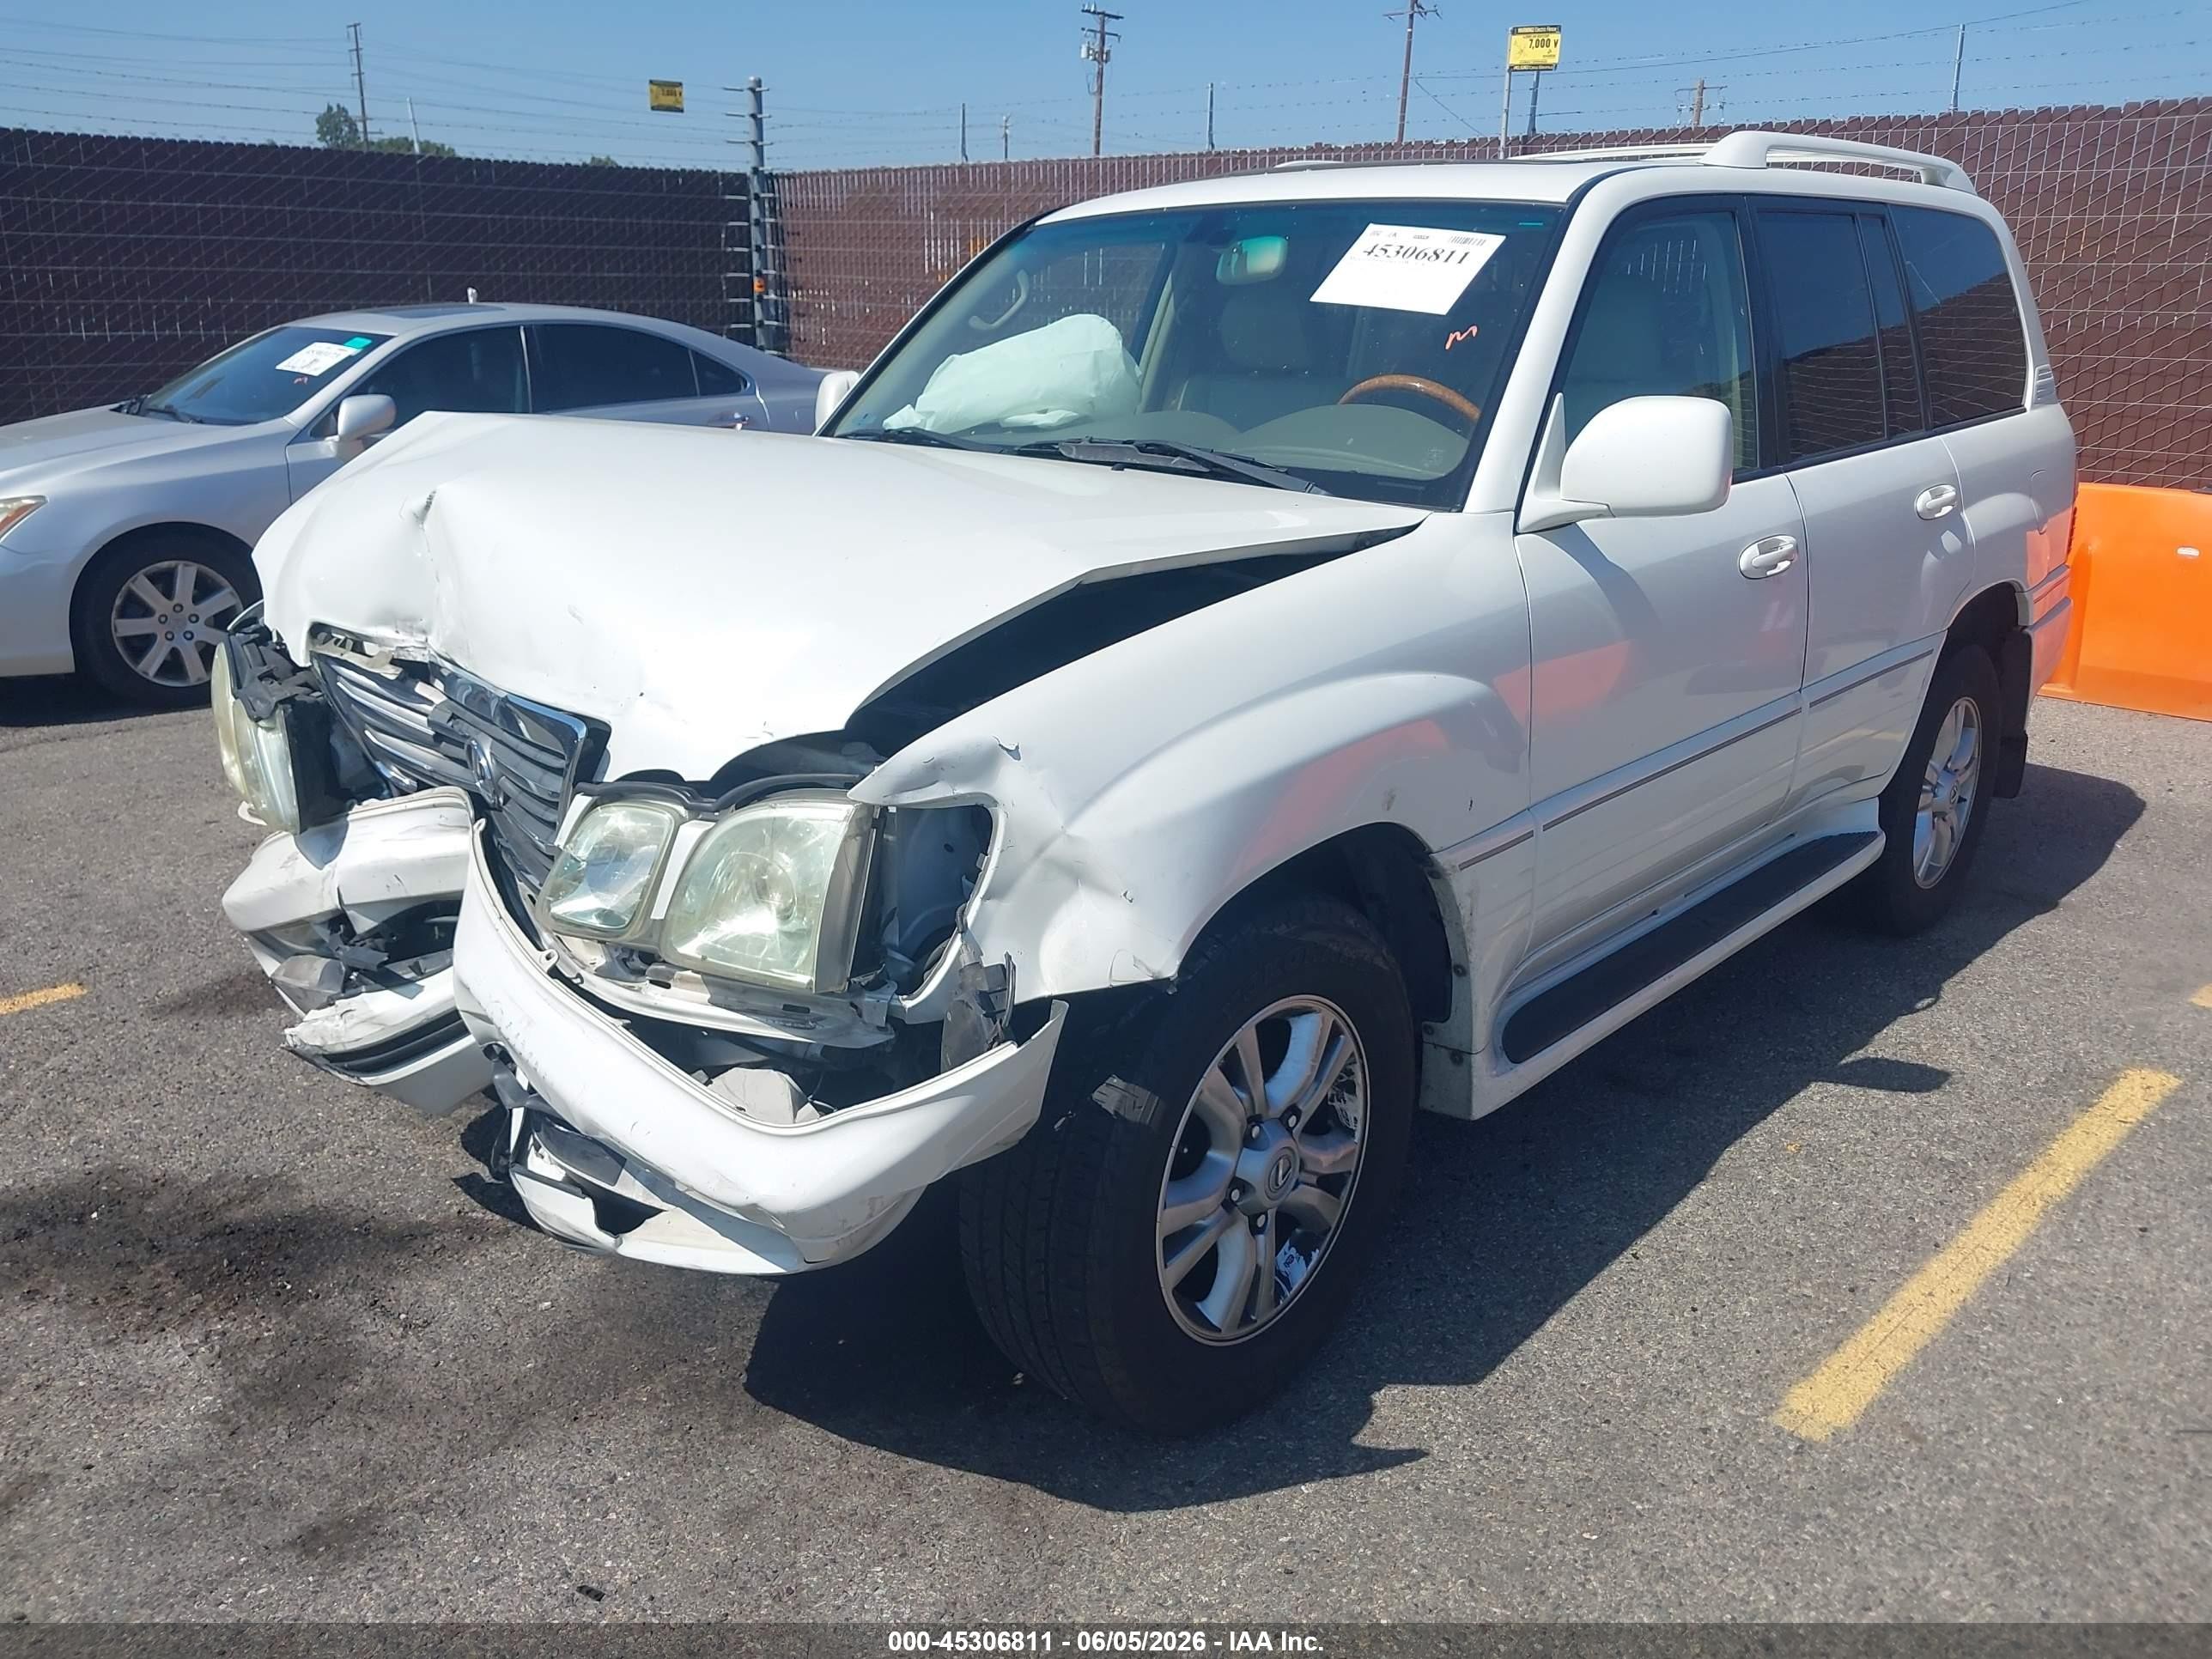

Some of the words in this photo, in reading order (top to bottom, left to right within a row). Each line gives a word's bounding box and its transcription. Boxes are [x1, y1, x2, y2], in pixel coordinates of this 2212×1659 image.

[1528, 38, 1551, 50] 7,000
[1553, 39, 1559, 48] V
[1363, 243, 1471, 266] 45306811
